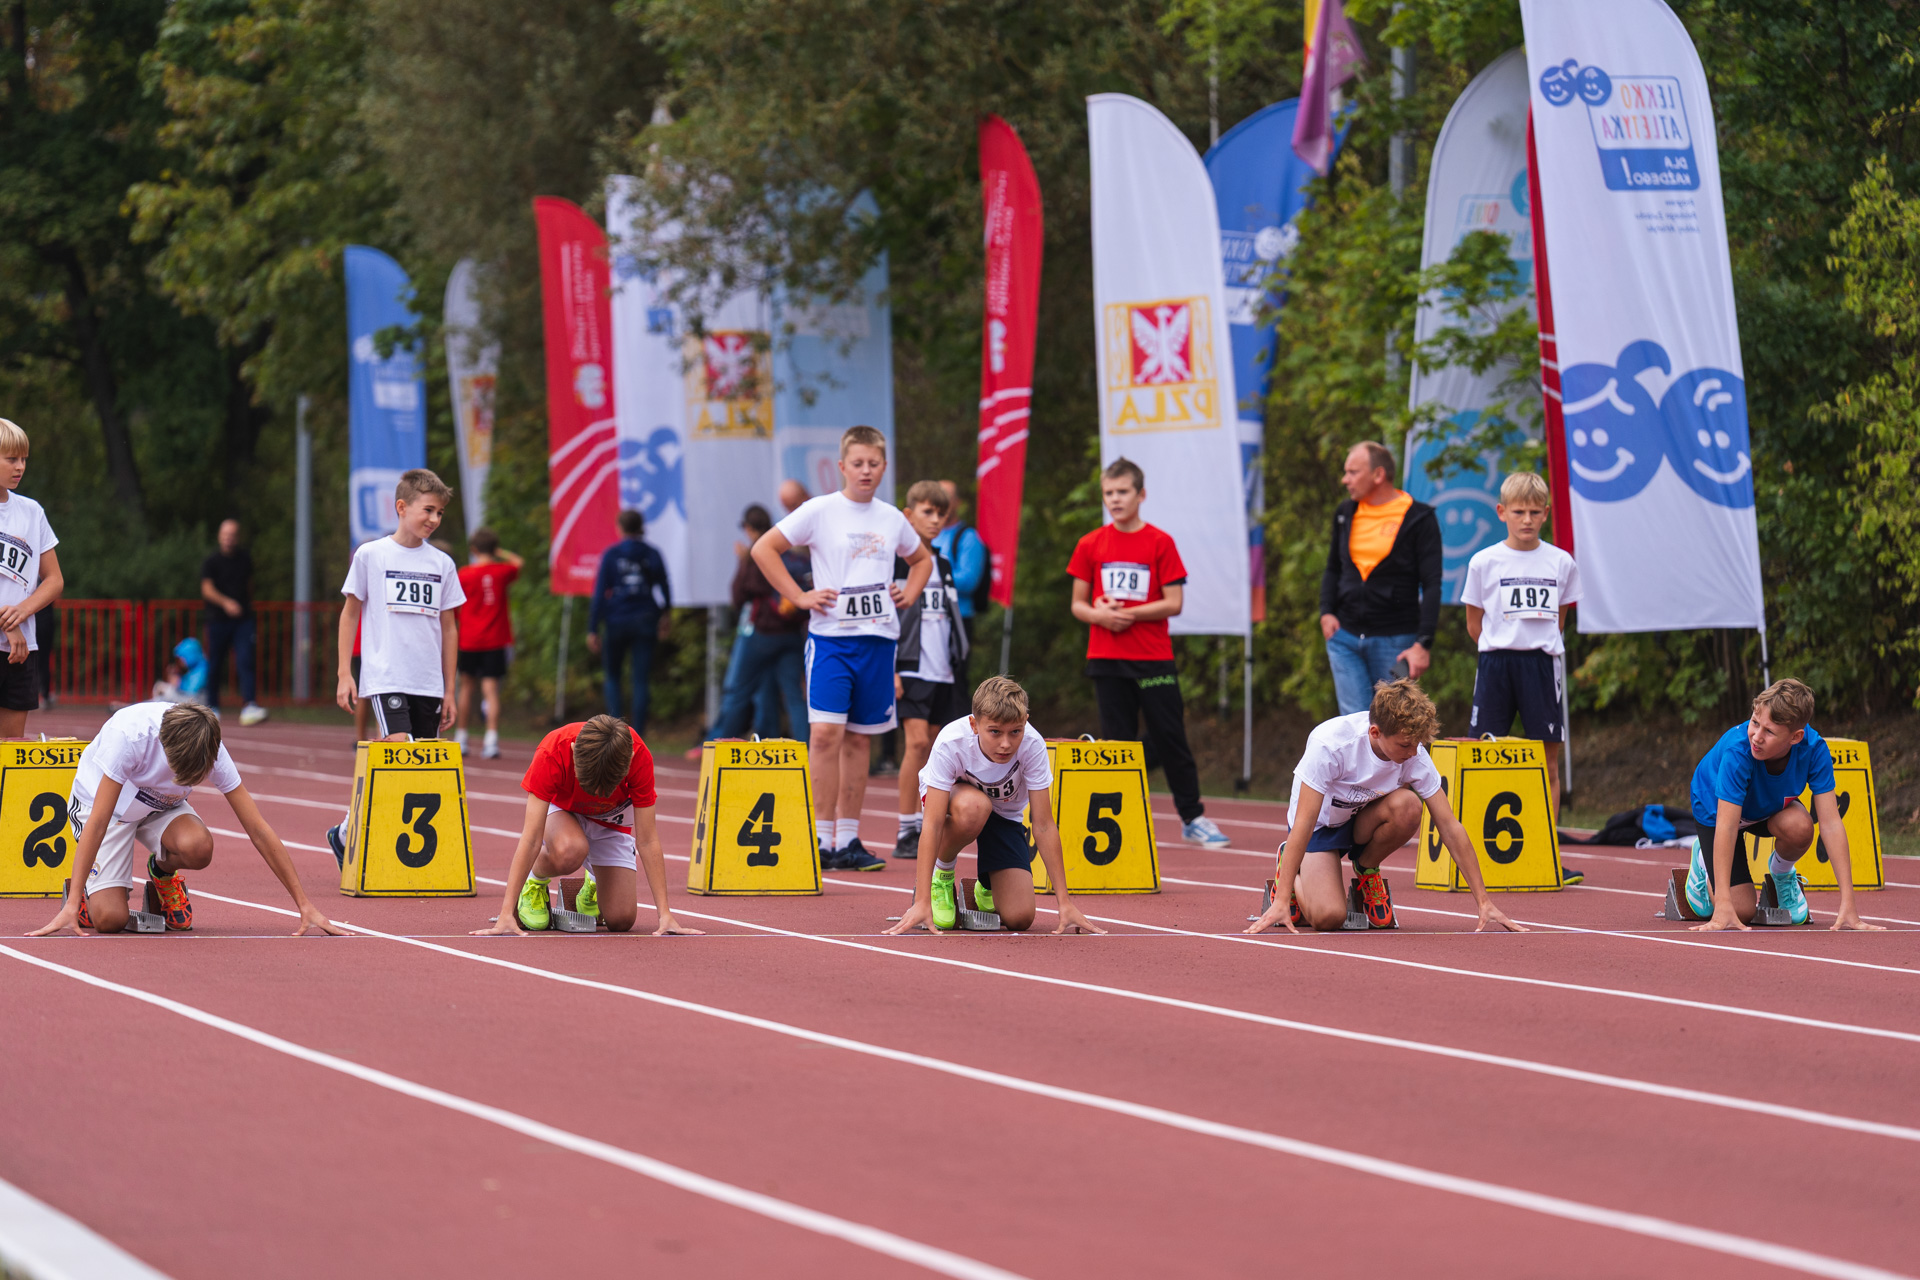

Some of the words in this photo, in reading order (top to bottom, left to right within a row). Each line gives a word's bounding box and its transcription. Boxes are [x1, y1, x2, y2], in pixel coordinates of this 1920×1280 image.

[1109, 571, 1138, 590] 129
[395, 581, 432, 605] 299
[1510, 587, 1550, 608] 492
[846, 593, 882, 616] 466
[384, 747, 450, 765] BOSiR
[731, 748, 798, 765] BOSiR
[1071, 748, 1135, 766] BOSiR
[1472, 747, 1536, 765] BOSiR
[1829, 749, 1860, 765] SiR
[23, 792, 68, 868] 2
[395, 792, 441, 868] 3
[737, 792, 781, 867] 4
[1083, 792, 1123, 866] 5
[1483, 791, 1524, 865] 6
